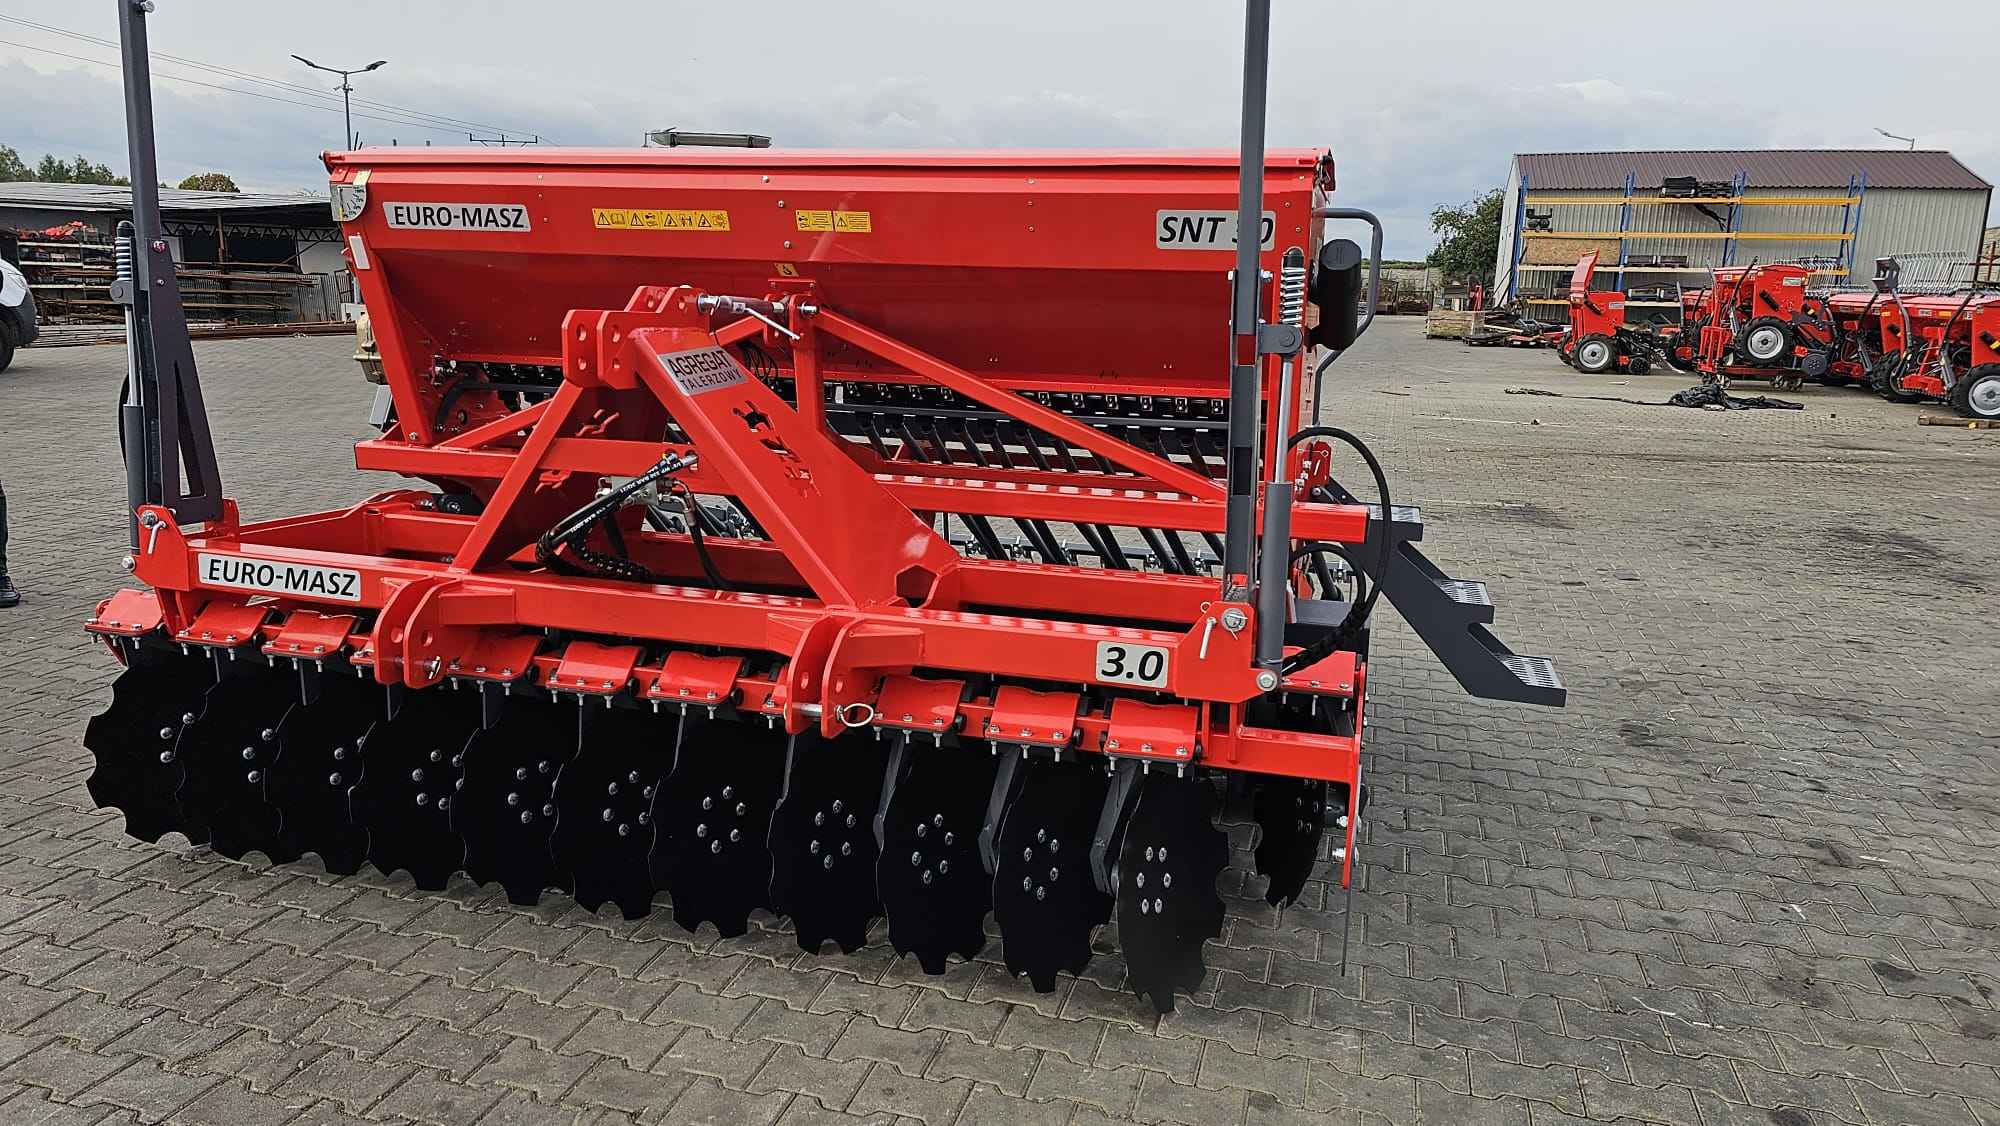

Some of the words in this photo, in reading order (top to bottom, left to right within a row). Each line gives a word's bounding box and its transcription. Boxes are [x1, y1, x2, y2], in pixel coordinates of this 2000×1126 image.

[394, 206, 524, 228] EURO-MASZ
[1159, 216, 1226, 243] SNT
[667, 350, 732, 378] AGREGAT
[680, 368, 742, 391] TALERZOWY
[208, 558, 356, 597] EURO-MASZ
[1101, 646, 1164, 681] 3.0
